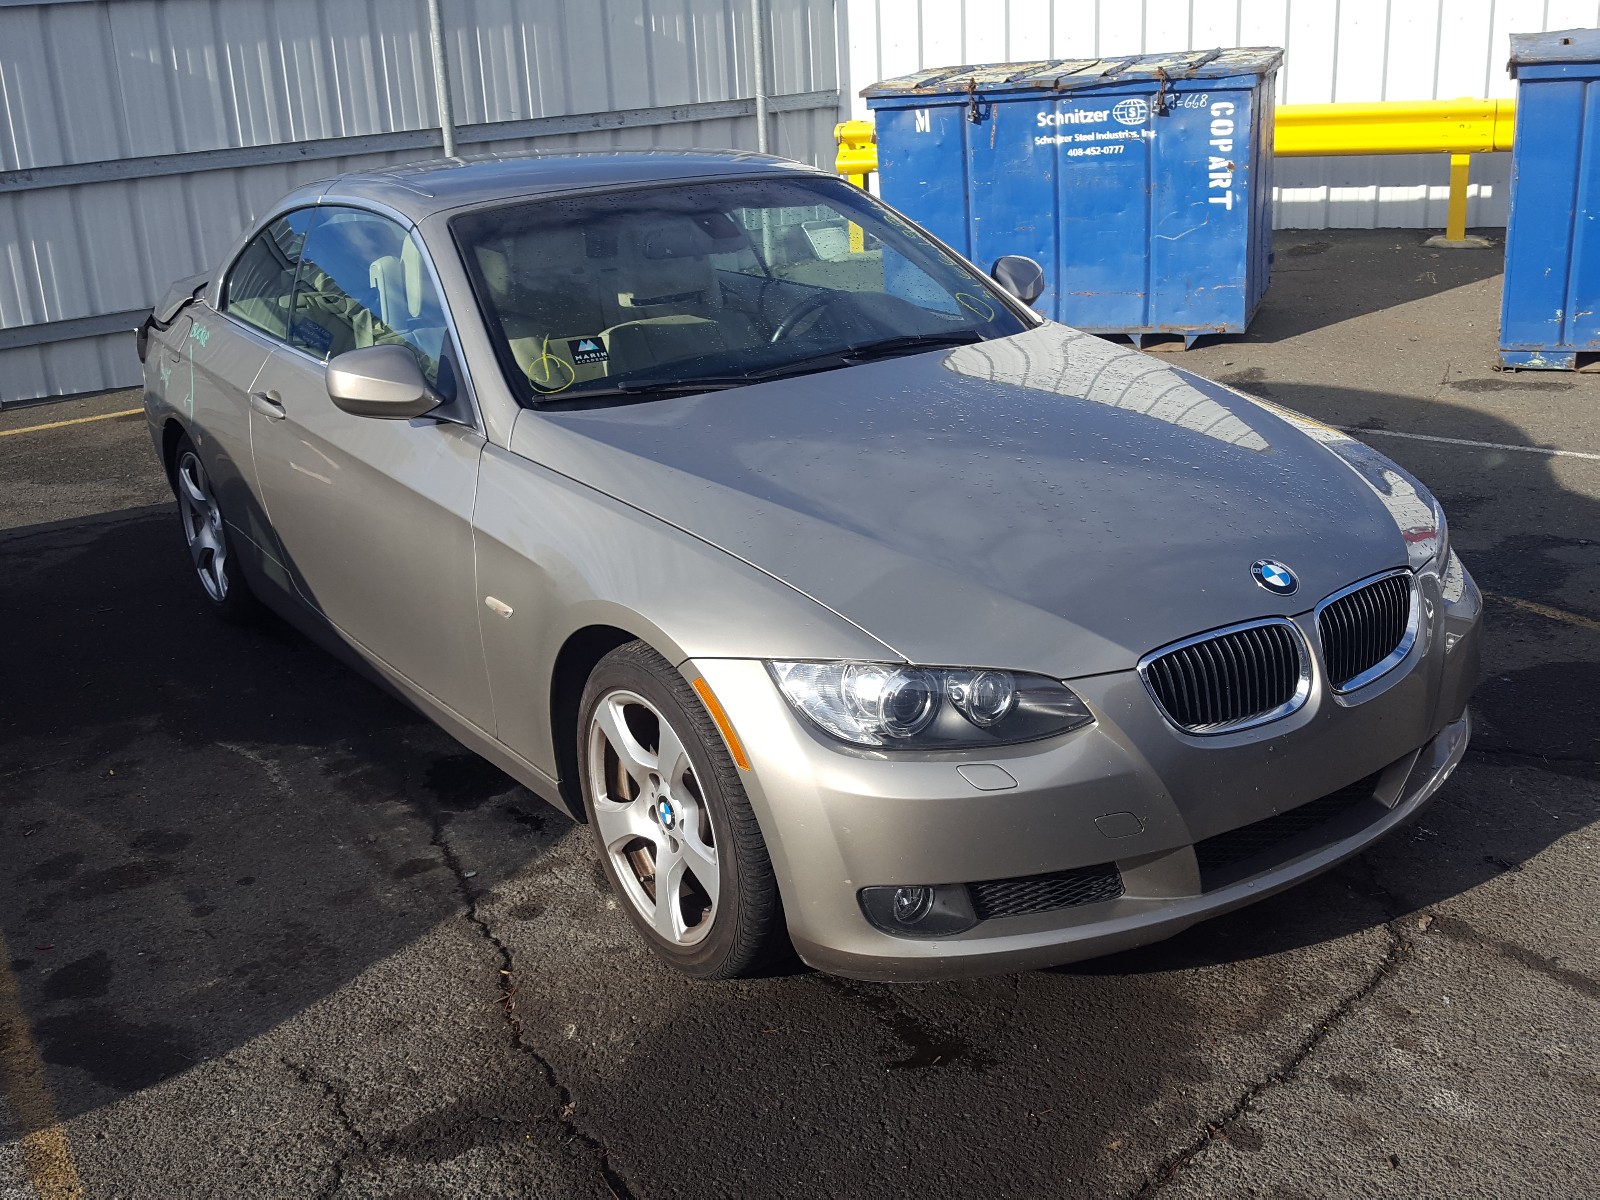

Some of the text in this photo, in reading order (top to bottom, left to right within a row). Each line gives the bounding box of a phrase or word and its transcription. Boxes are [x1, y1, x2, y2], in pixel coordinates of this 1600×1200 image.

[1036, 108, 1110, 127] Schnitzer
[1074, 131, 1095, 142] Steel
[1067, 145, 1125, 157] 408-452-0777
[575, 351, 608, 361] MARIN
